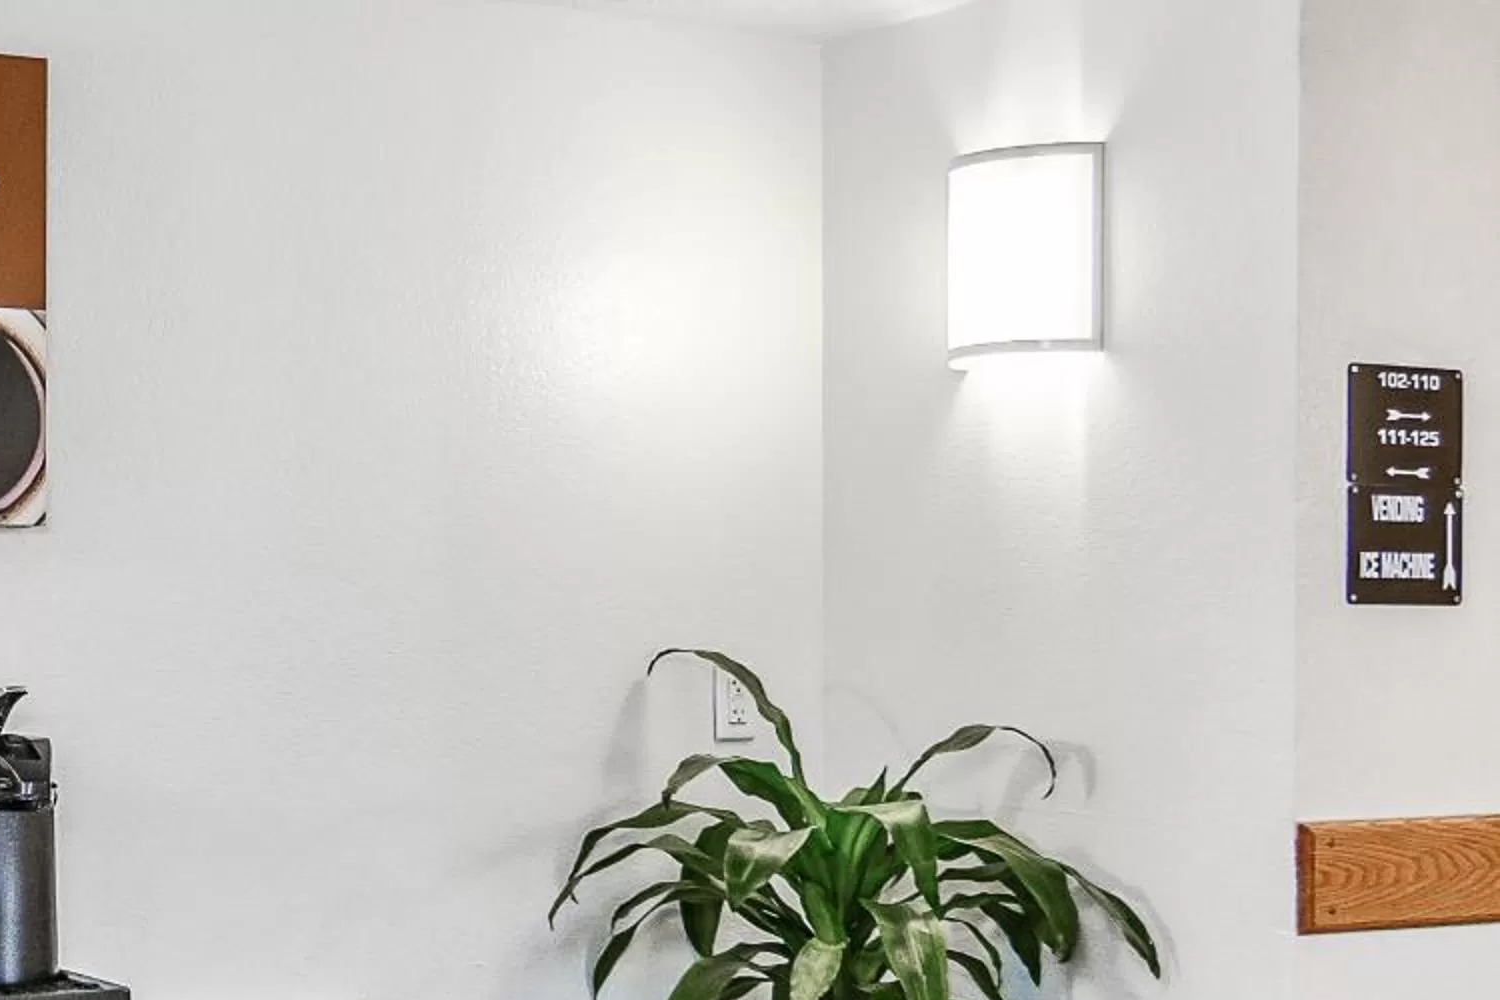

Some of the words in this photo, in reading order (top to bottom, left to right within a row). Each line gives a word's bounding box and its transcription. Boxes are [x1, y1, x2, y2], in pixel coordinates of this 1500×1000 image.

[1376, 371, 1441, 391] 102-110
[1376, 428, 1441, 447] 111-125
[1371, 494, 1426, 523] VENDING
[1359, 551, 1380, 579] ICE
[1381, 551, 1436, 580] MACHINE
